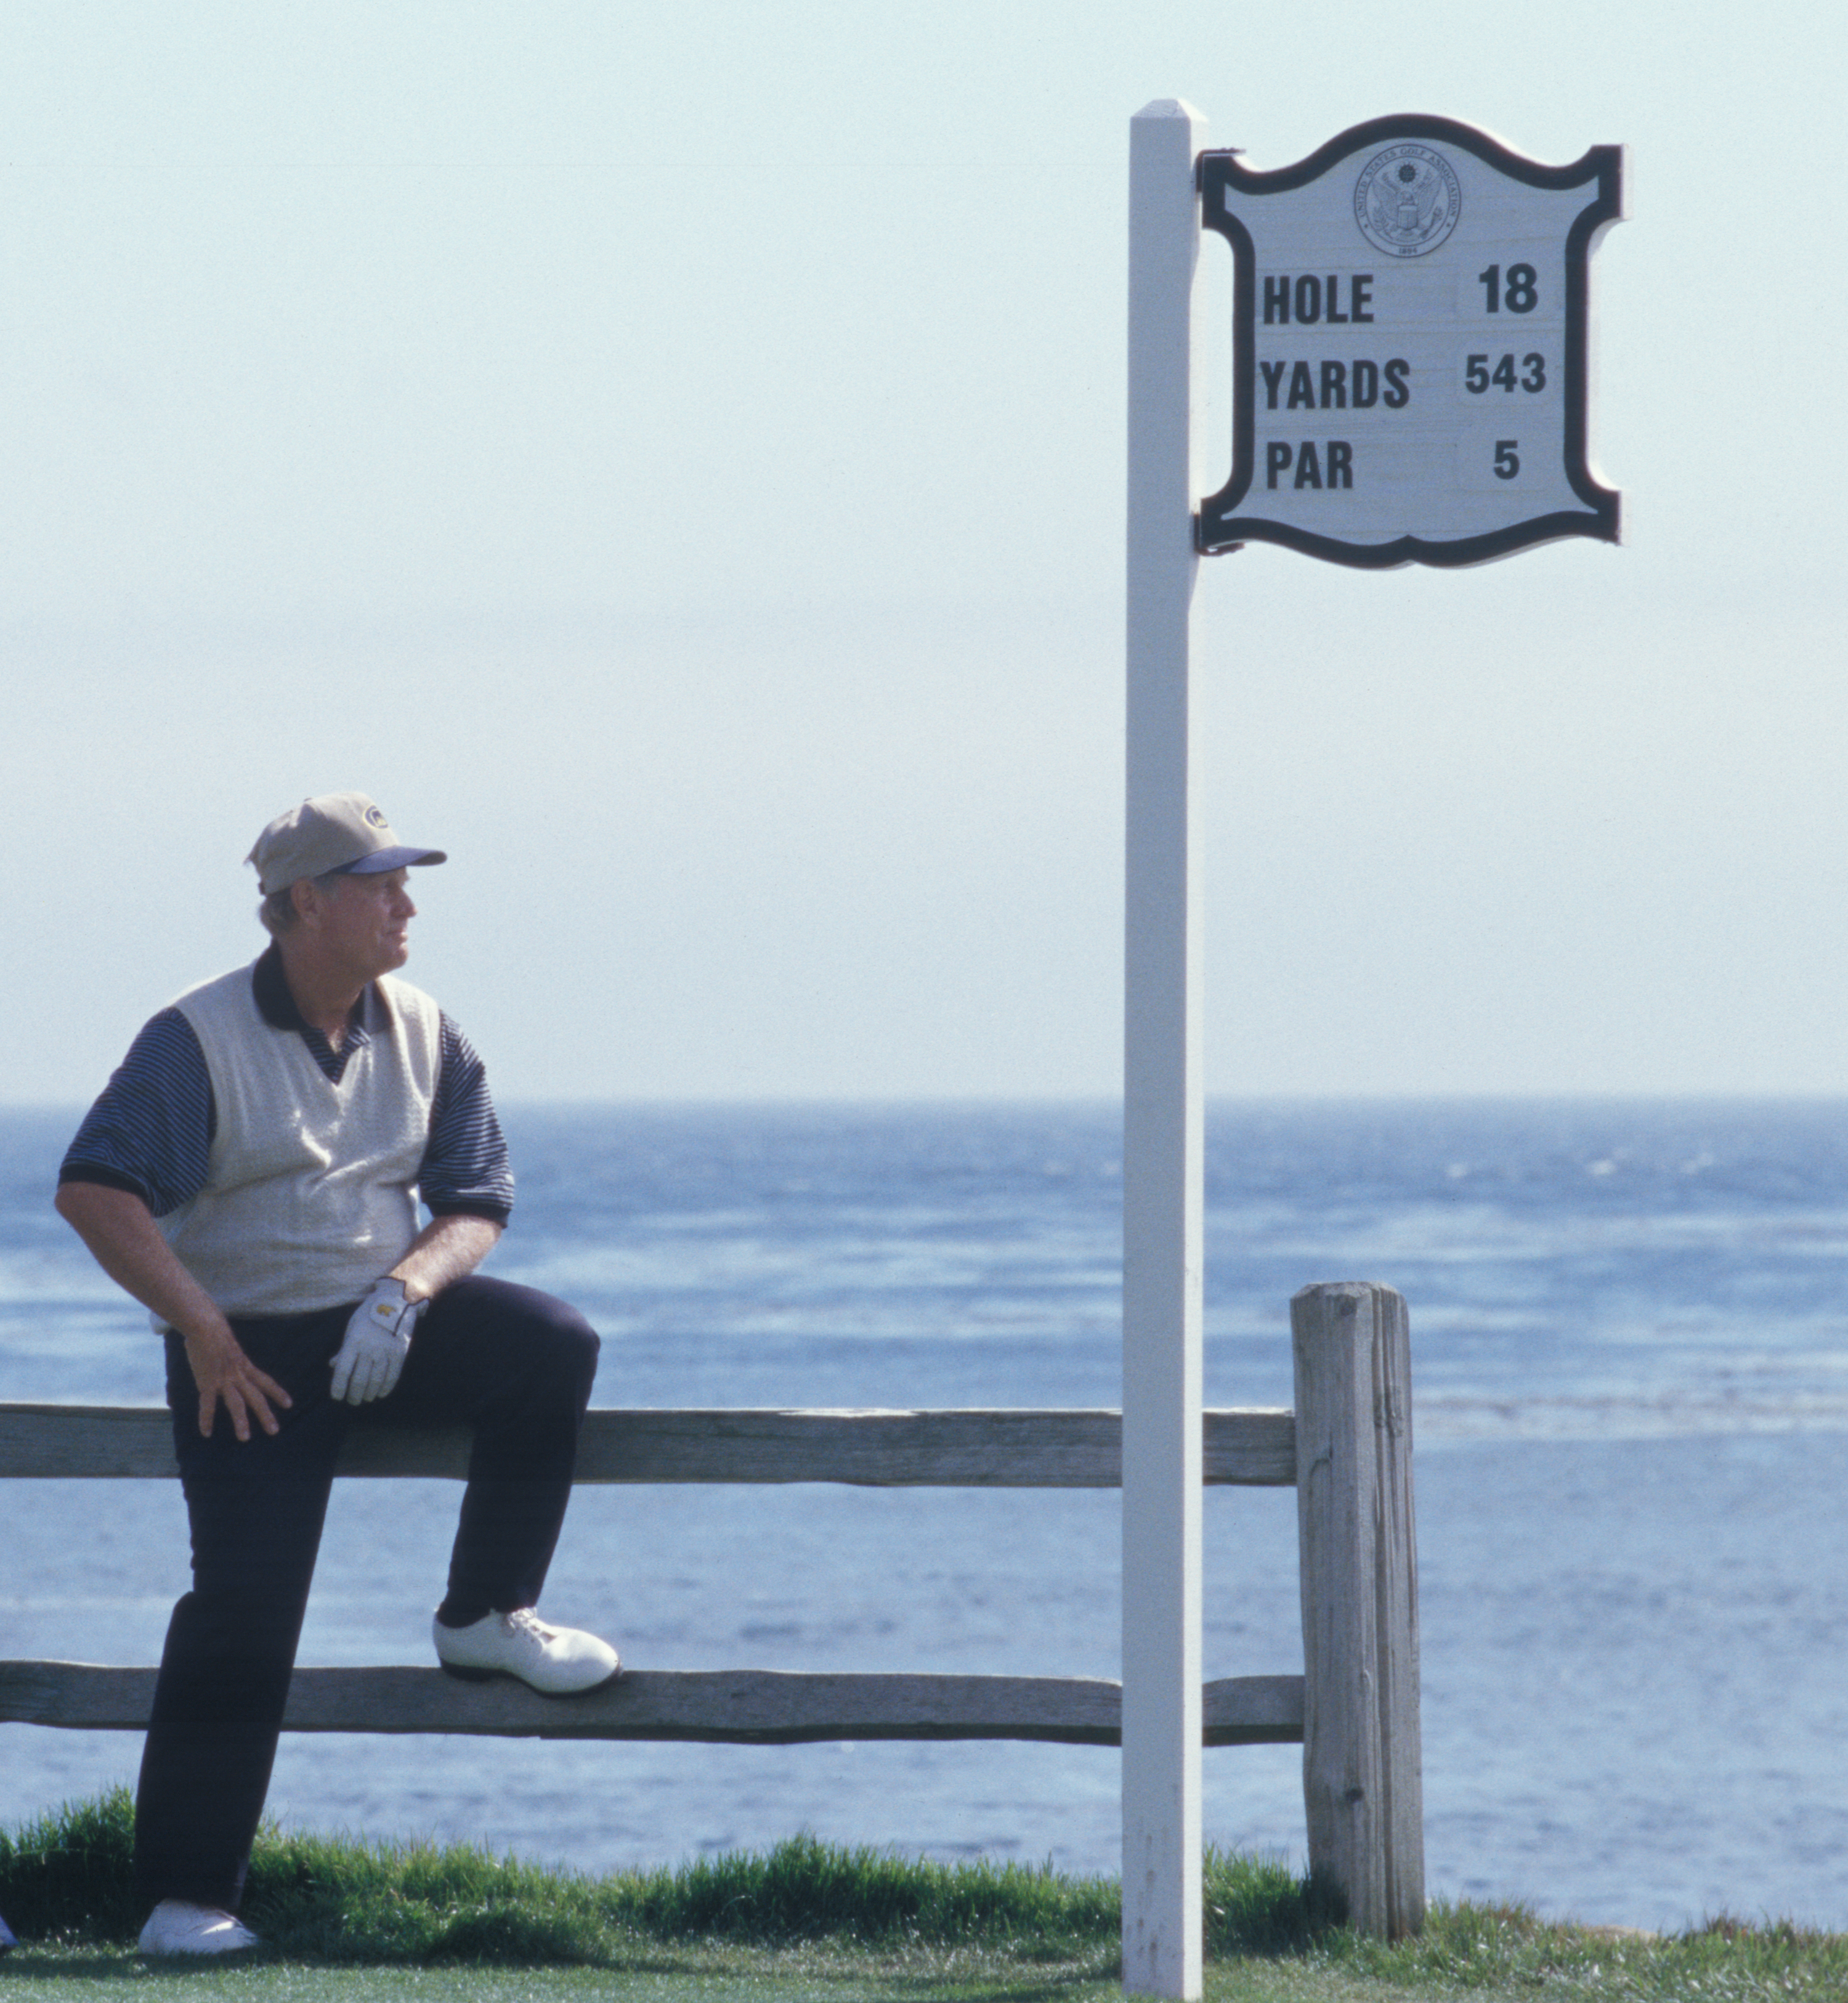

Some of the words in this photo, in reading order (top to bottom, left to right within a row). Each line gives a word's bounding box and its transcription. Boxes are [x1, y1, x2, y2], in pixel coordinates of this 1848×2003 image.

[1356, 181, 1367, 216] UNITED
[1366, 150, 1396, 178] STATES
[1400, 147, 1425, 156] GOLF
[1429, 155, 1458, 217] ASSOCIATION
[1264, 275, 1373, 324] HOLE
[1480, 264, 1537, 313] 18
[1260, 359, 1409, 409] YARDS
[1466, 353, 1545, 393] 543
[1267, 441, 1352, 489] PAR
[1494, 441, 1519, 479] 5
